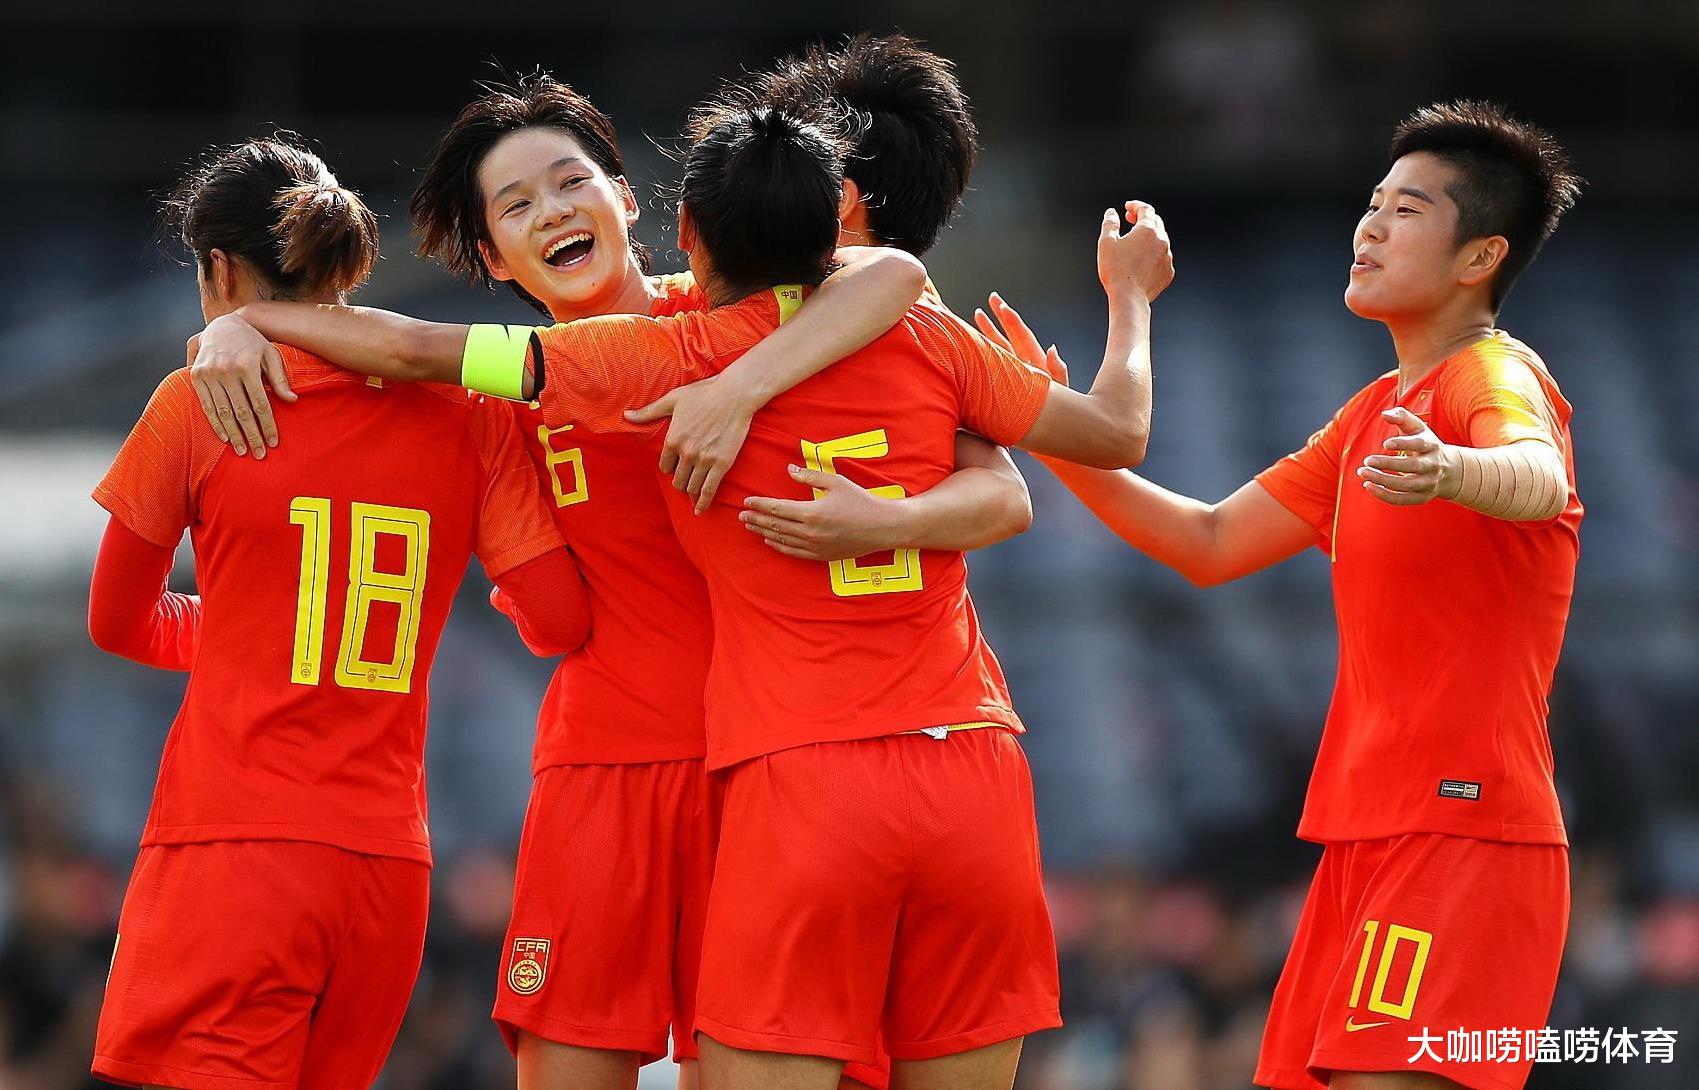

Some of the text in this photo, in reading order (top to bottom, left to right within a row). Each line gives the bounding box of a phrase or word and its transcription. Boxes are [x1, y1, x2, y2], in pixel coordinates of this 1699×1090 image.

[781, 290, 798, 299] 中国
[538, 425, 589, 508] 6
[290, 496, 430, 693] 18
[516, 941, 547, 953] CFA
[1348, 920, 1433, 1020] 10
